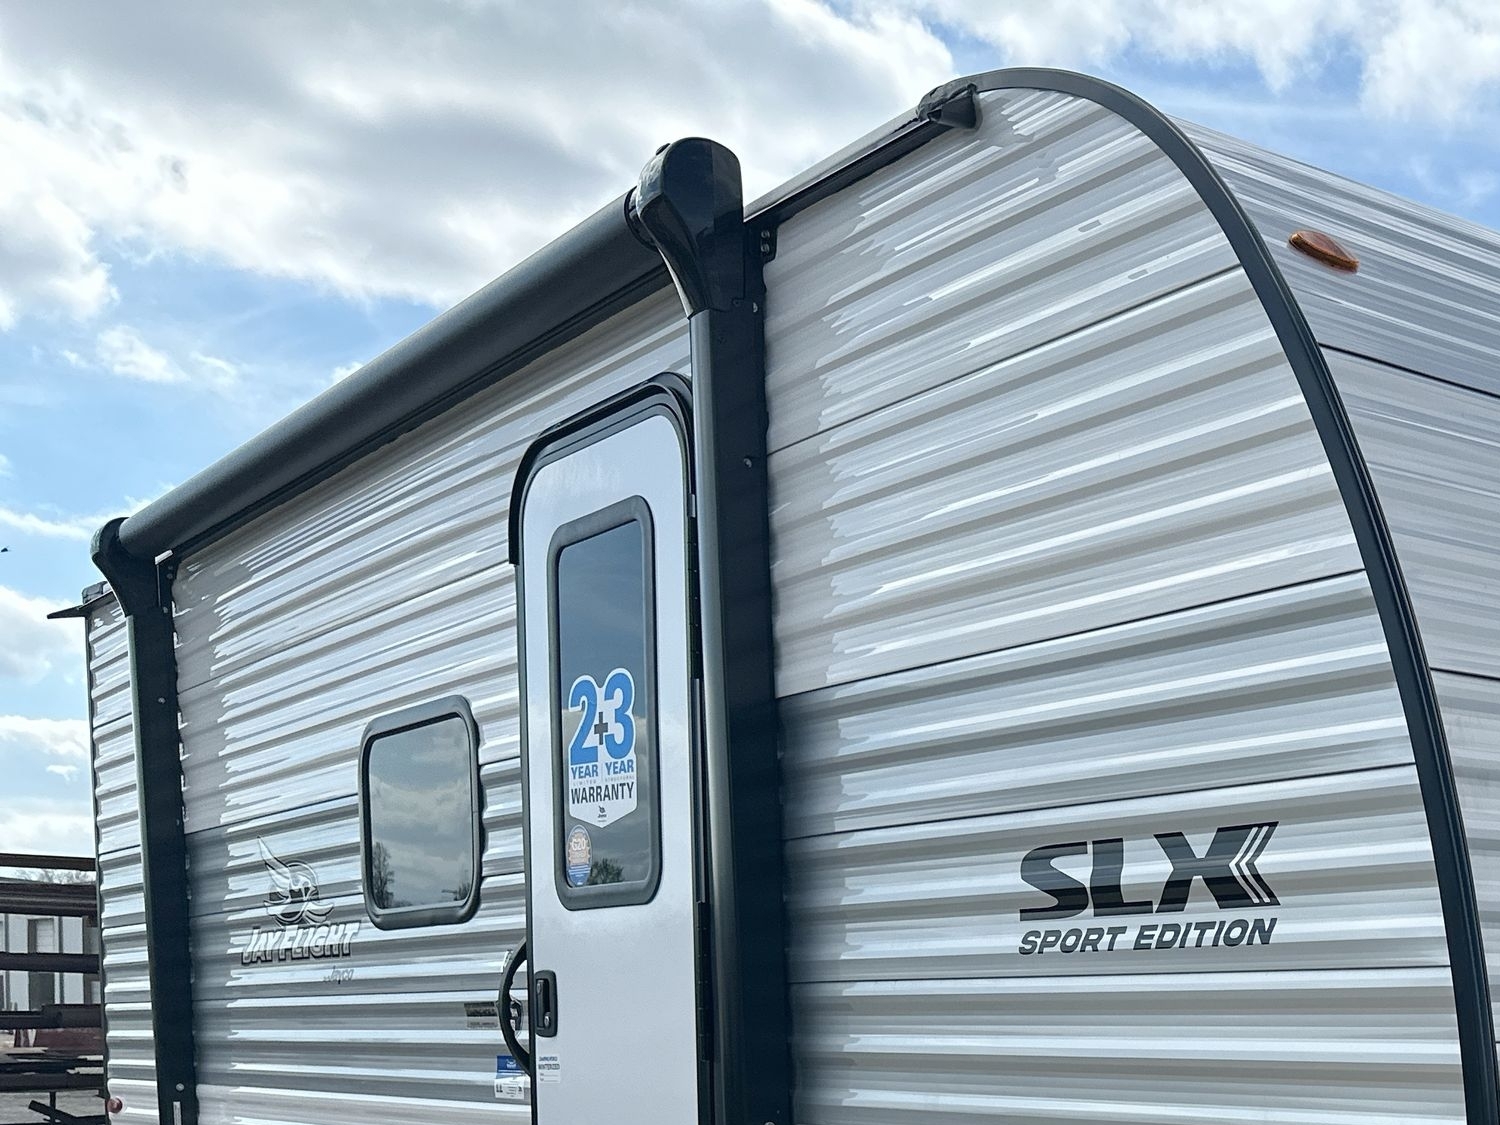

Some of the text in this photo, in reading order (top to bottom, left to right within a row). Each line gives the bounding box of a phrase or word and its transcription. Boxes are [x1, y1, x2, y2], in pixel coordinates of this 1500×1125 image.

[571, 759, 634, 780] YEAR YEAR
[571, 782, 634, 804] WARRANTY
[1019, 821, 1281, 921] SLX
[241, 920, 361, 965] JAY FLIGHT
[1018, 917, 1278, 955] SPORT EDITION
